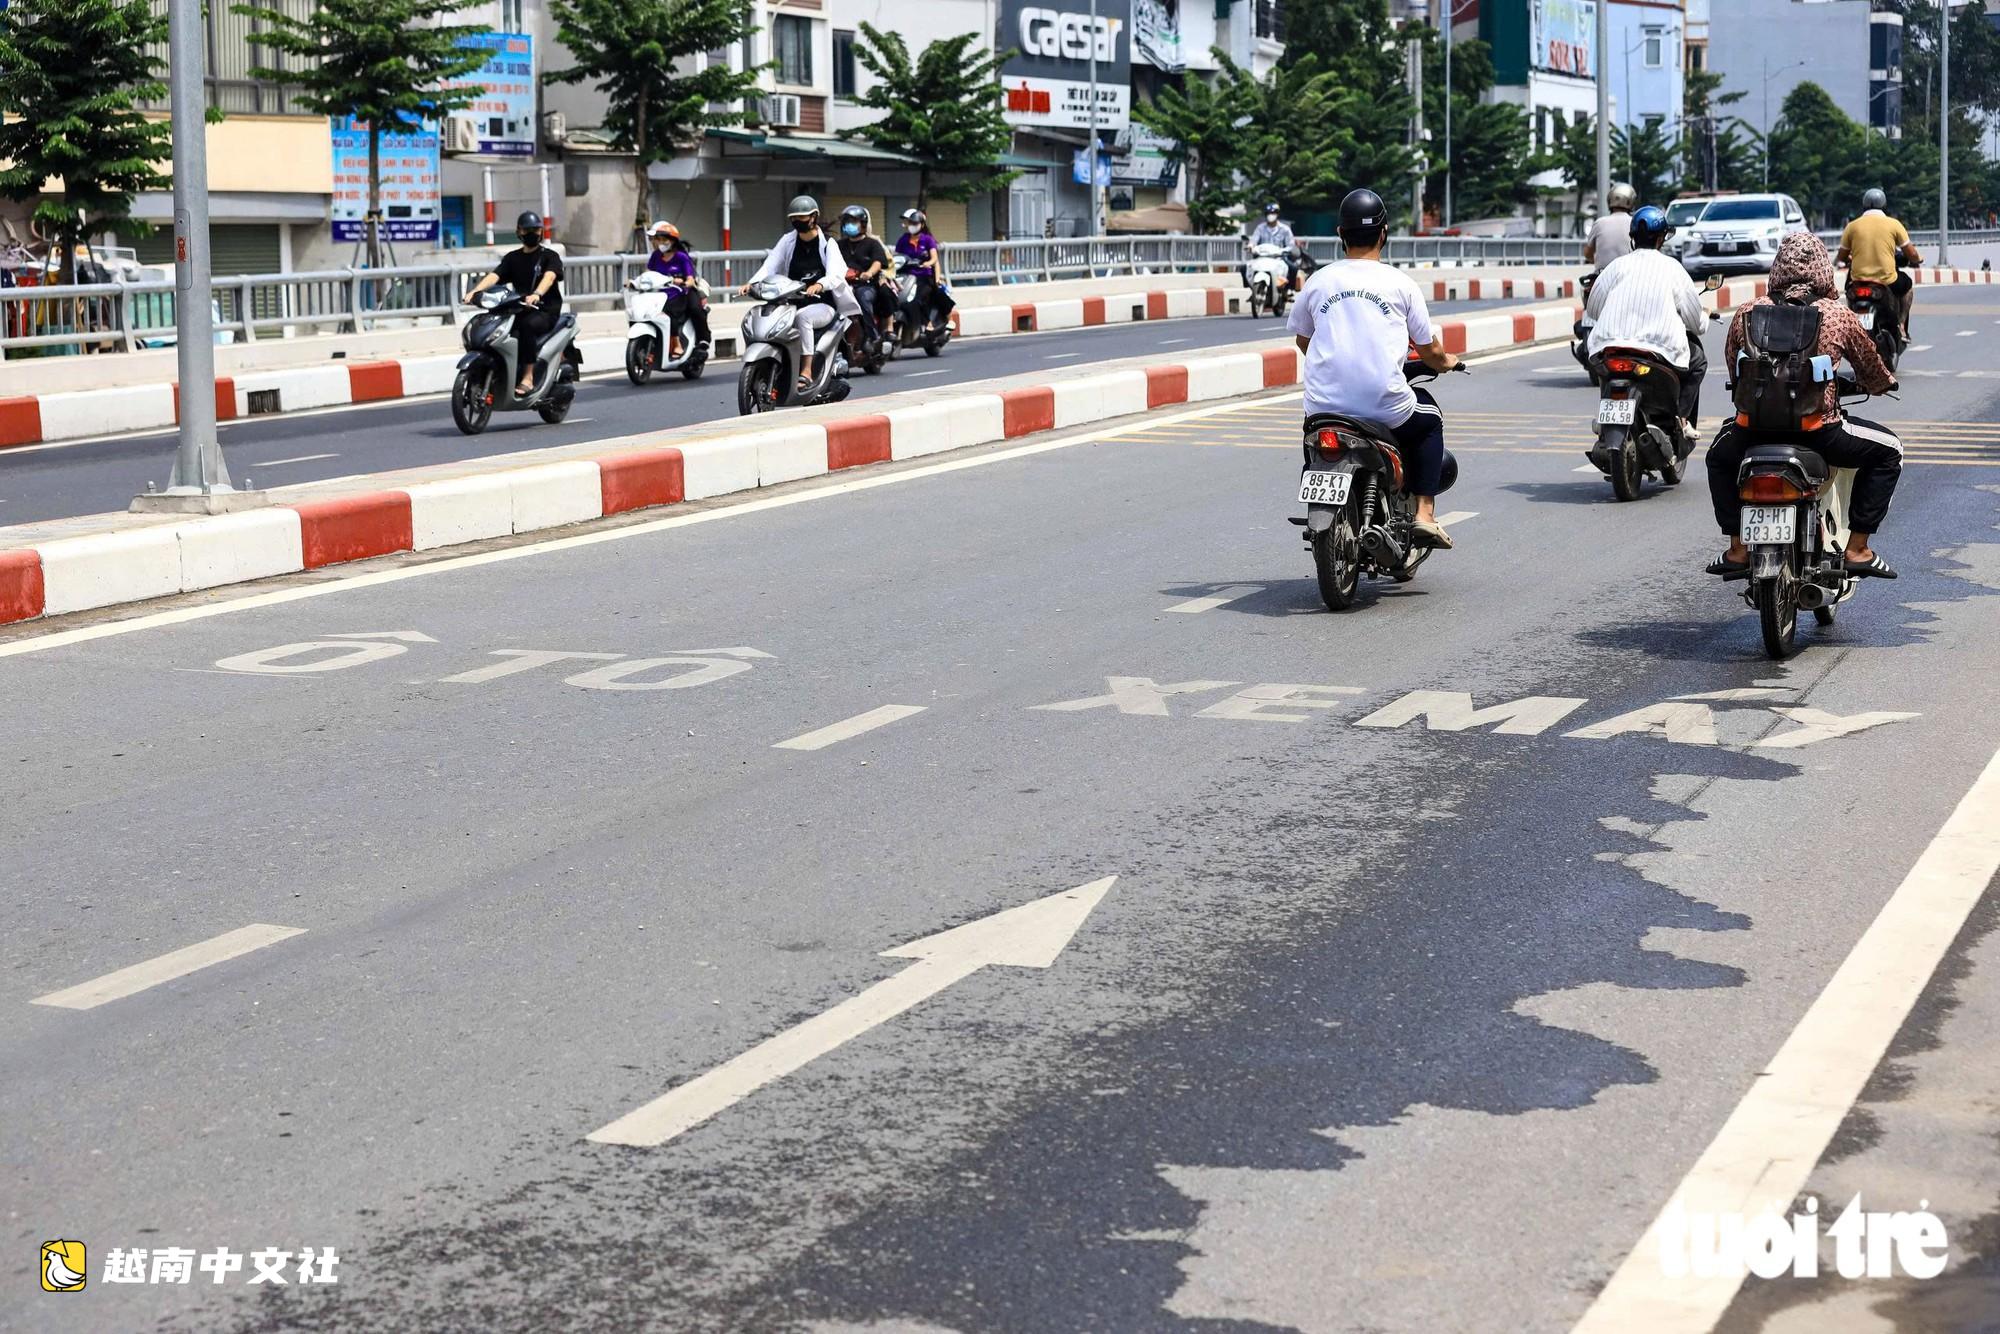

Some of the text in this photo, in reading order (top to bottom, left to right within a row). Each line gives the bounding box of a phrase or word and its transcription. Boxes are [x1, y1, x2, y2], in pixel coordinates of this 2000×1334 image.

[1340, 290, 1356, 299] KINH
[1309, 474, 1344, 488] 89-K1
[1301, 487, 1346, 502] 082.39
[1749, 508, 1787, 524] 29-H1
[1024, 675, 1367, 723] XE
